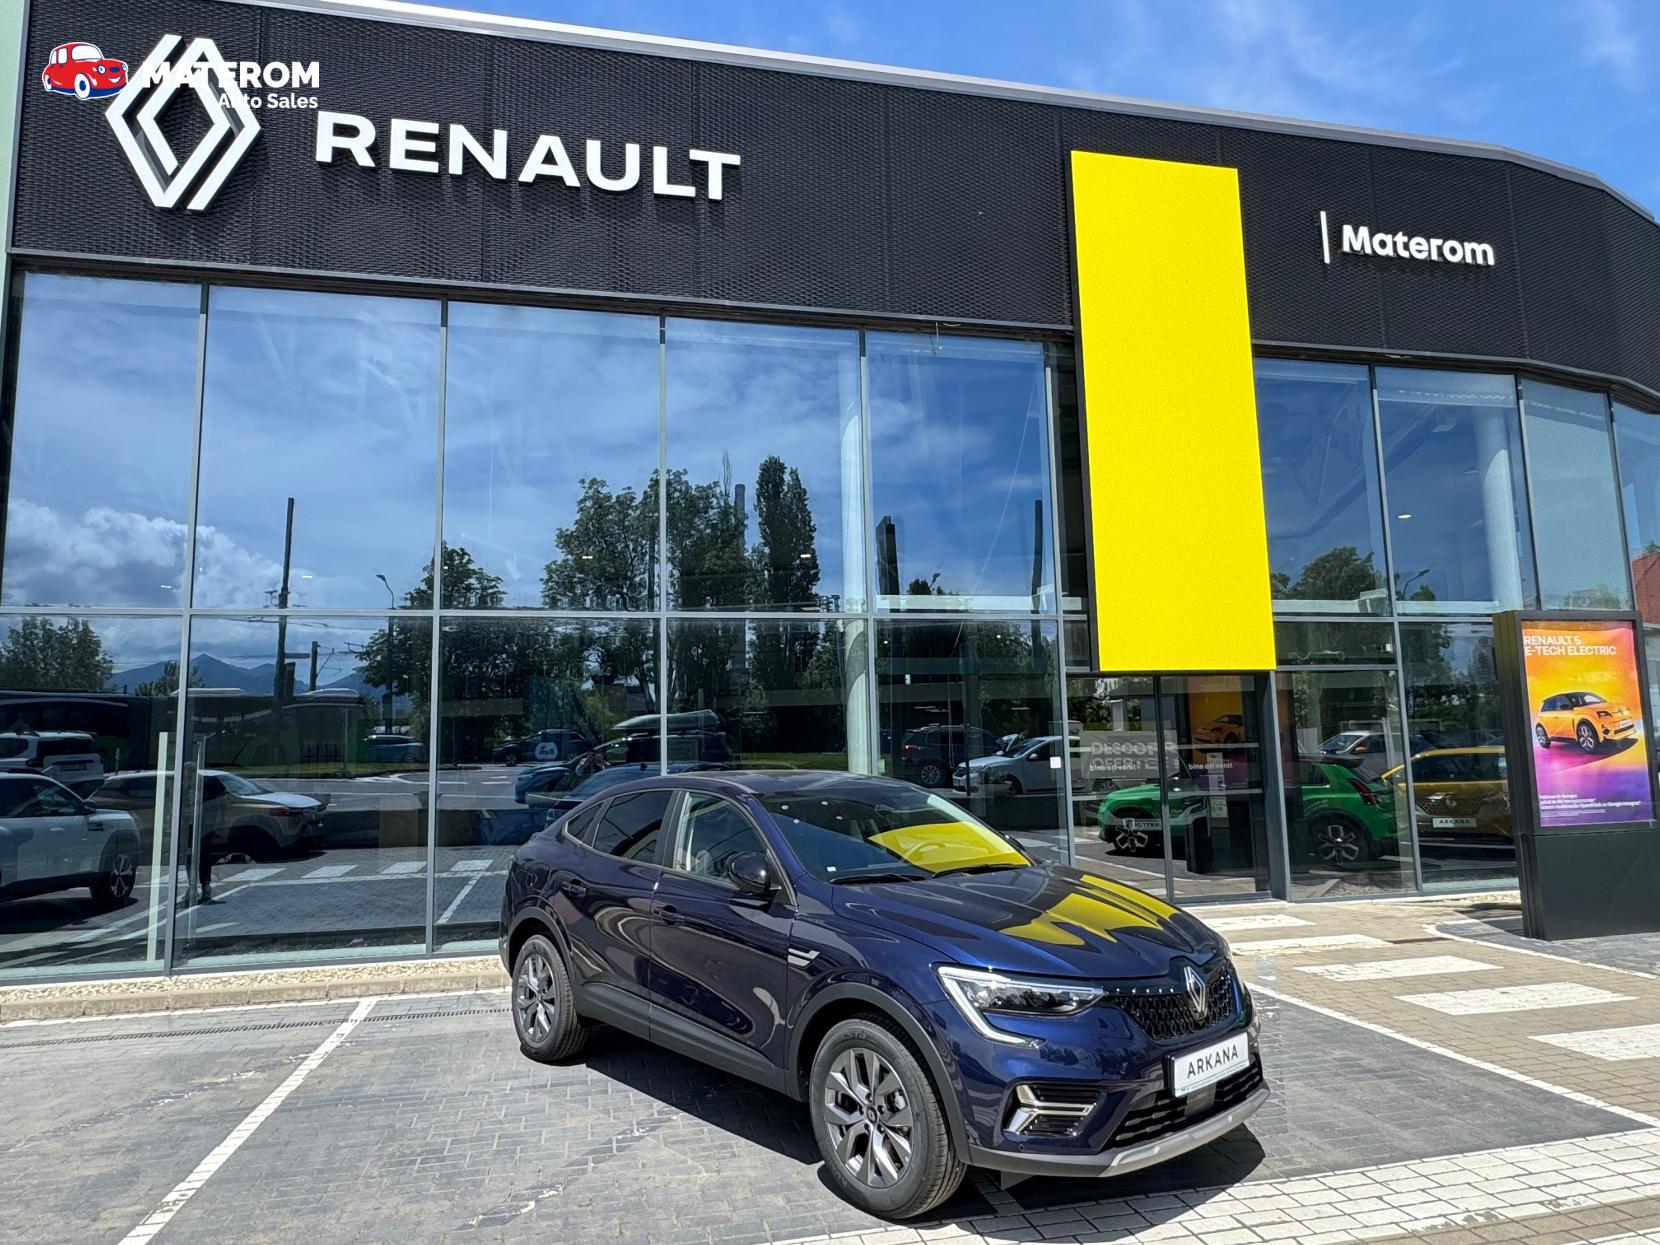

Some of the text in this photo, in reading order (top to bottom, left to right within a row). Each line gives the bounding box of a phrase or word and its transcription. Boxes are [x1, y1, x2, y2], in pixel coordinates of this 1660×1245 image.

[315, 111, 741, 201] RENAULT
[1342, 224, 1495, 266] Materom
[1523, 635, 1582, 645] RENAULT 5
[1524, 645, 1617, 656] E-TECH ELECTRIC
[1187, 1044, 1239, 1079] ARKANA
